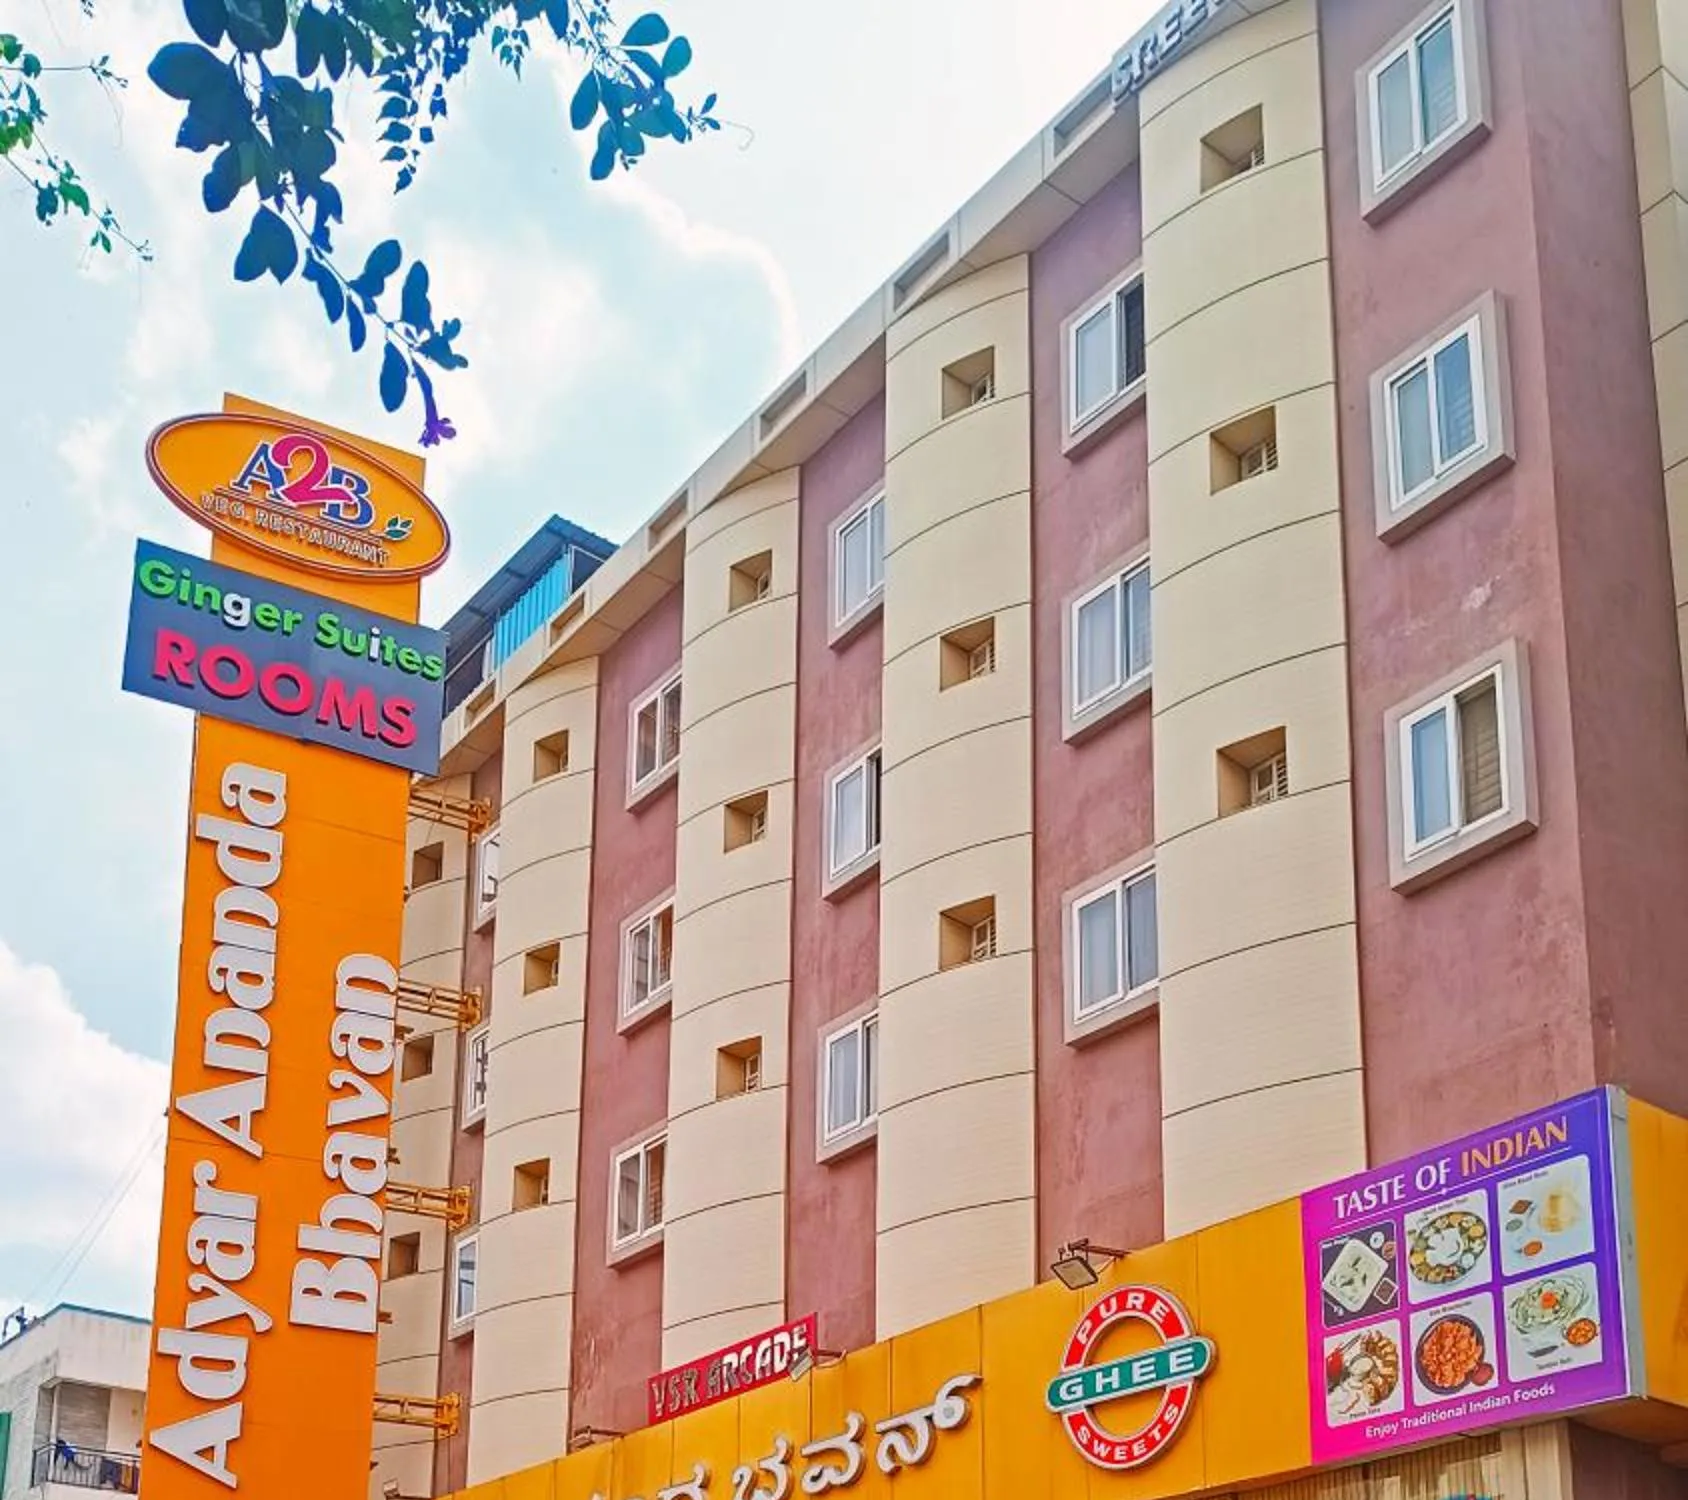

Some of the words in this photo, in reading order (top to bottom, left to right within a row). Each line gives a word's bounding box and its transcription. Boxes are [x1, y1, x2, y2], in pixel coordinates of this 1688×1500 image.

[232, 432, 374, 529] A2B
[254, 506, 390, 568] RESTAURANT
[138, 558, 304, 636] Ginger
[314, 611, 445, 682] Suites
[152, 628, 418, 748] ROOMS
[175, 761, 288, 1159] Ananda
[288, 953, 399, 1335] Bhavan
[1333, 1174, 1406, 1219] TASTE
[1415, 1157, 1453, 1191] OF
[1460, 1116, 1569, 1177] INDIAN
[149, 1159, 273, 1490] Adyar
[706, 1323, 808, 1399] ARCADE
[1076, 1292, 1169, 1345] PURE
[1059, 1346, 1195, 1401] GHEE
[1365, 1420, 1399, 1439] Enjoy
[1402, 1401, 1468, 1429] Traditional
[1469, 1393, 1512, 1413] Indian
[1514, 1382, 1556, 1402] Foods
[1077, 1404, 1179, 1461] SWEETS
